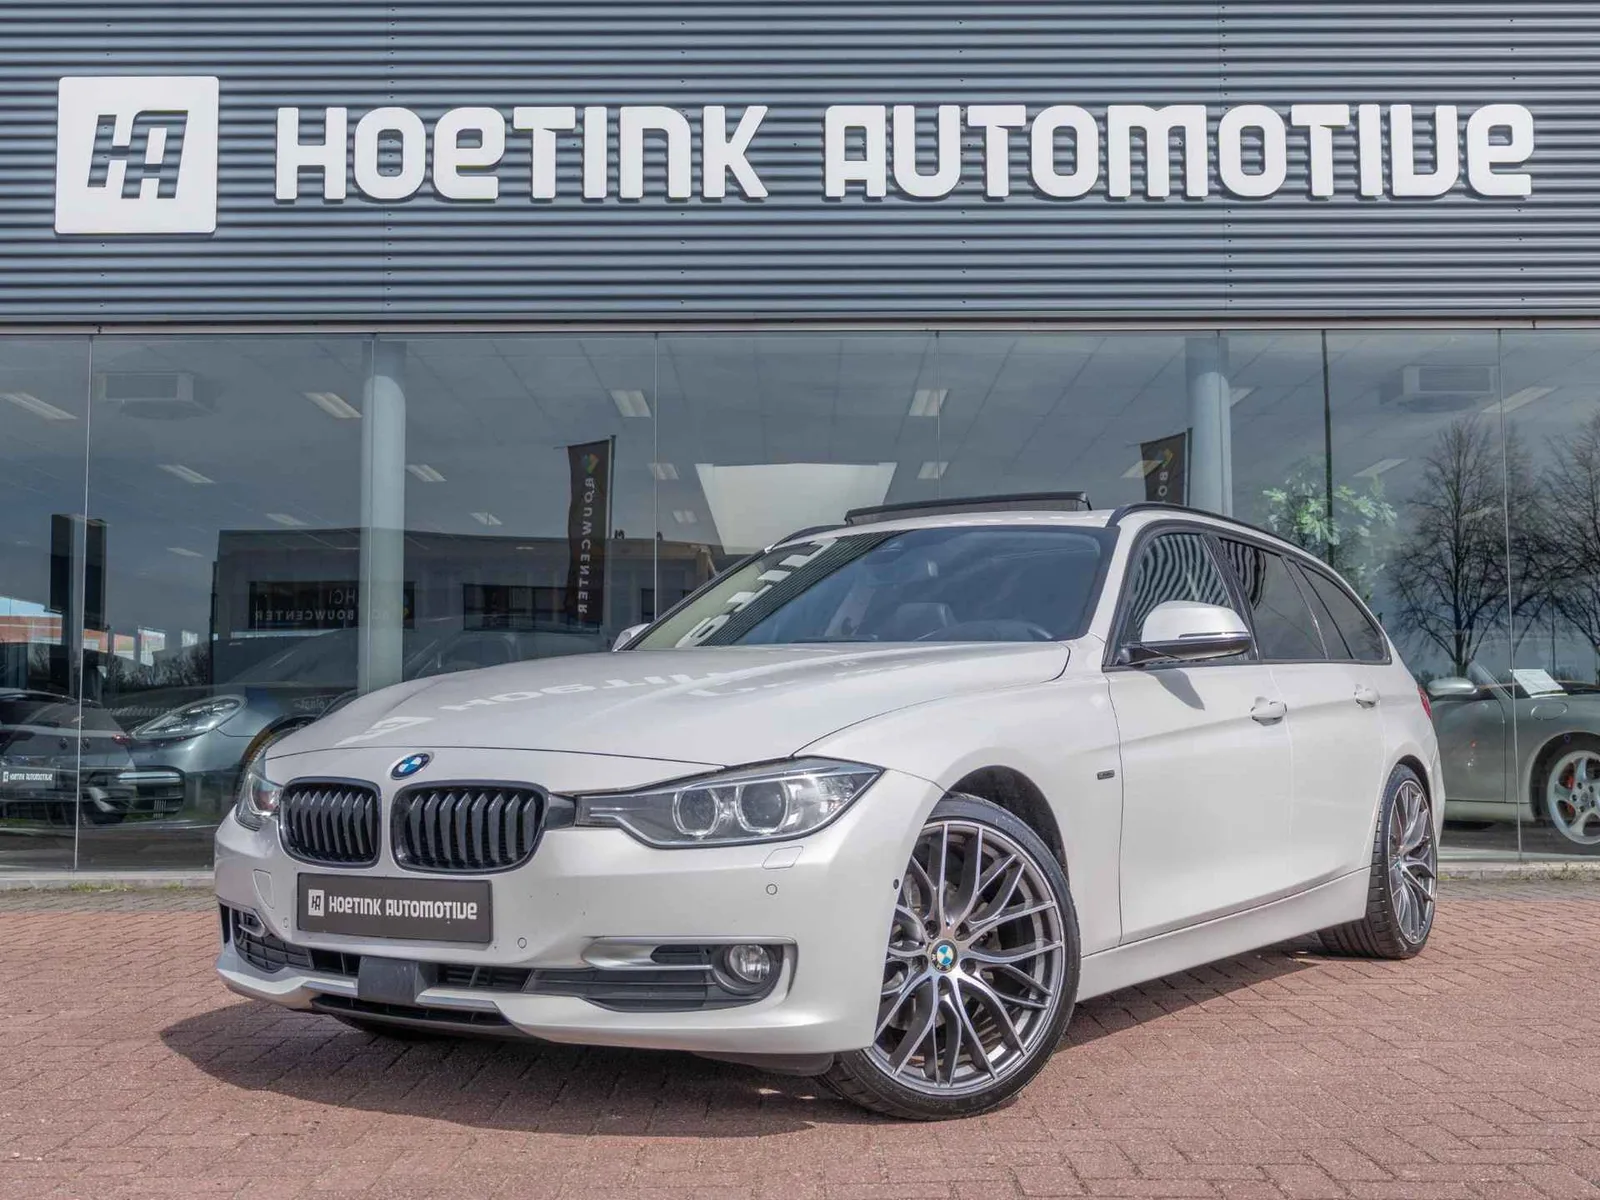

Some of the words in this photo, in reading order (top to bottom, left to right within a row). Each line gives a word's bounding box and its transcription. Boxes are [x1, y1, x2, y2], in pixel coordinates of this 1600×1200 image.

[275, 105, 769, 200] HOETINK
[824, 103, 1535, 198] AUTOMOTIVE
[329, 895, 382, 915] HOETINK
[386, 899, 477, 919] AUTOMOTIVE
